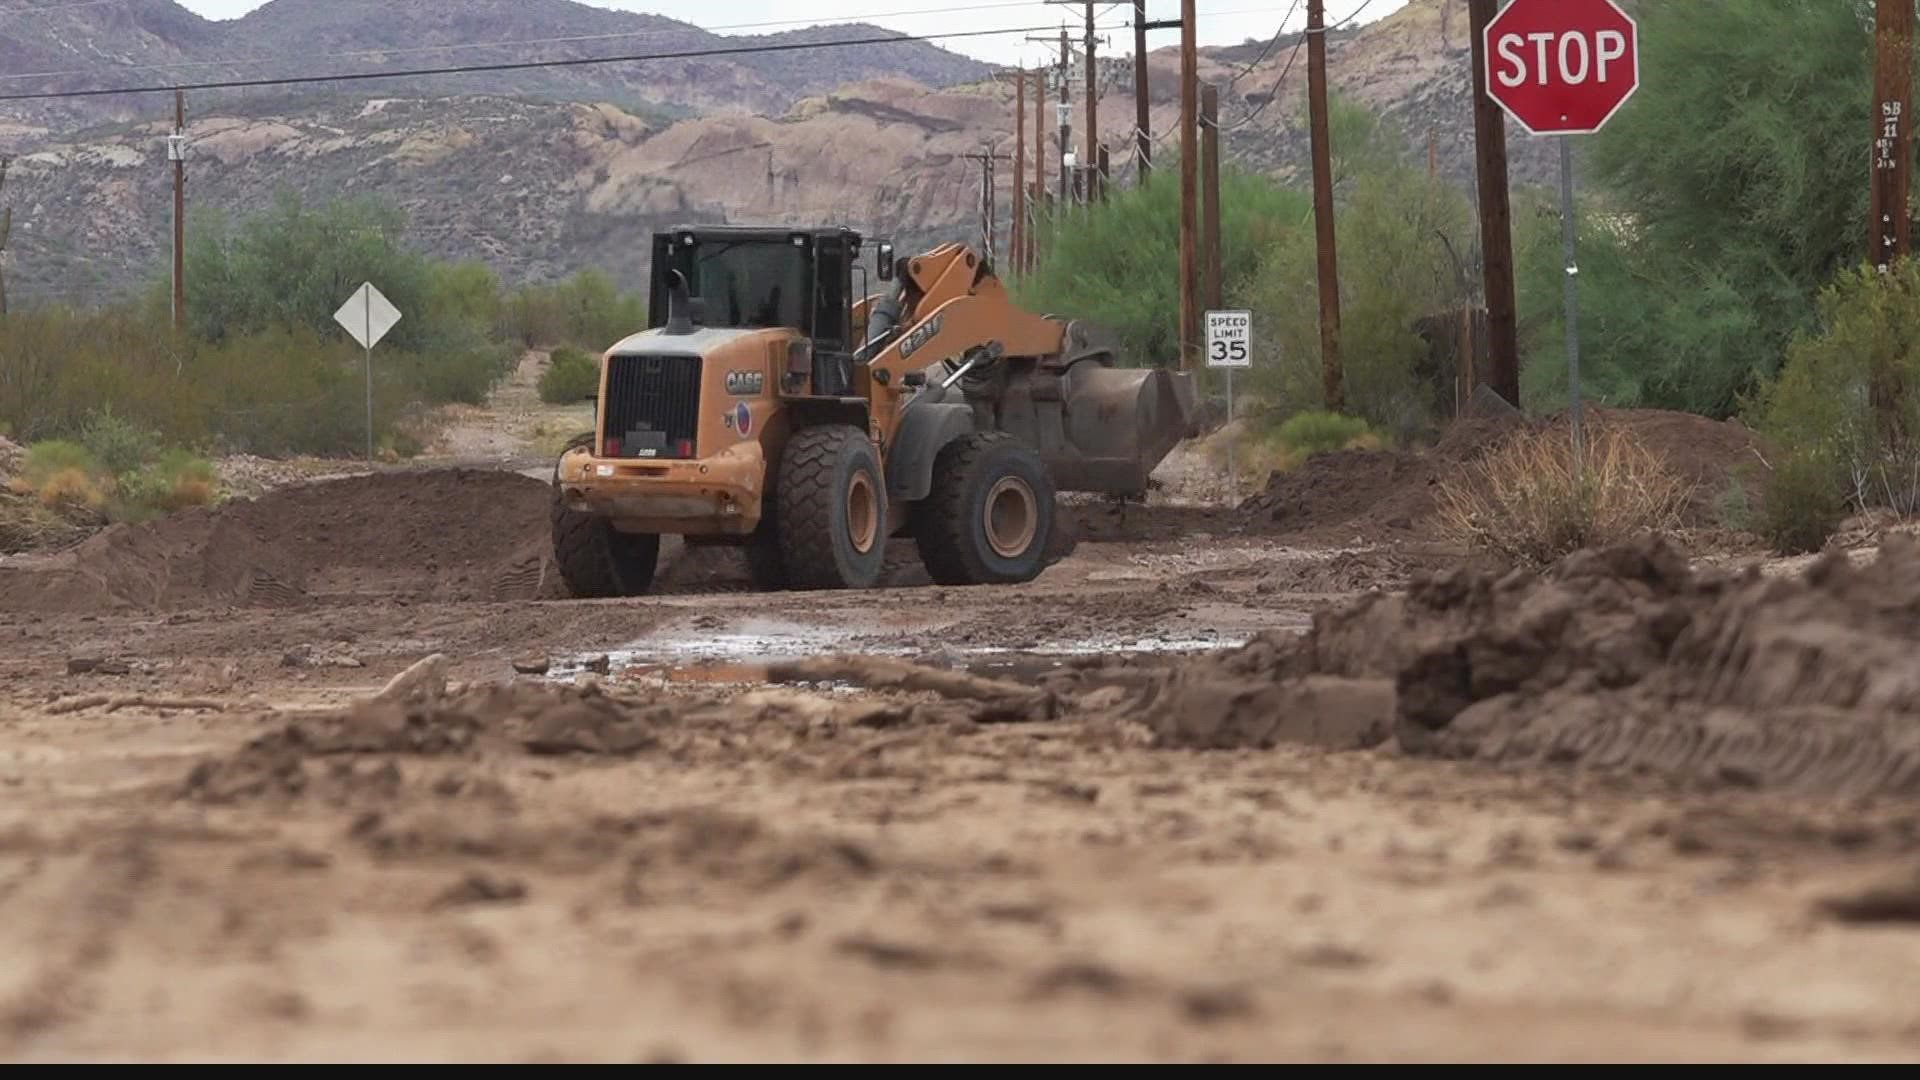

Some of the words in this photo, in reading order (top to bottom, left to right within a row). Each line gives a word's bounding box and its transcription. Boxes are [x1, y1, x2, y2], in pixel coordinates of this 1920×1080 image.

[1497, 30, 1625, 87] STOP
[1211, 317, 1247, 327] SPEED
[1214, 329, 1243, 338] LIMIT
[1211, 341, 1247, 360] 35
[726, 370, 764, 394] CASE
